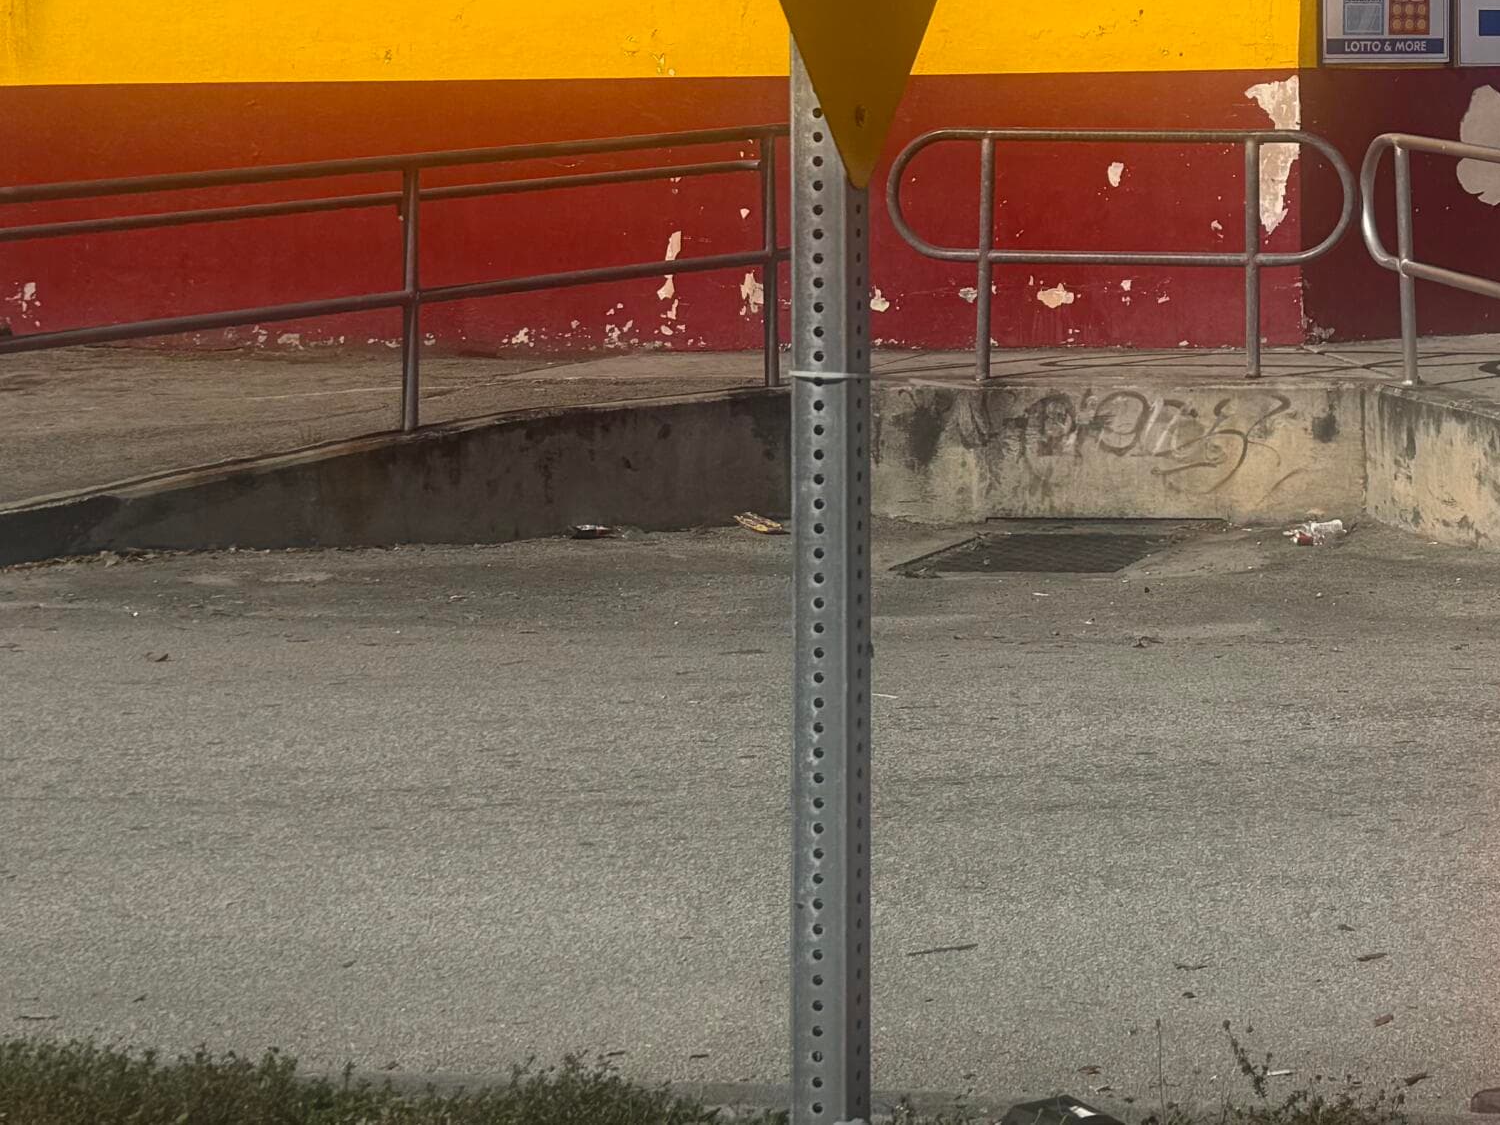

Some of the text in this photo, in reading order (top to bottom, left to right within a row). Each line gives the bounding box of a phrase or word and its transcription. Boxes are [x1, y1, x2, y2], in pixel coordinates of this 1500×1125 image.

[1344, 40, 1427, 52] LOTTO & MORE
